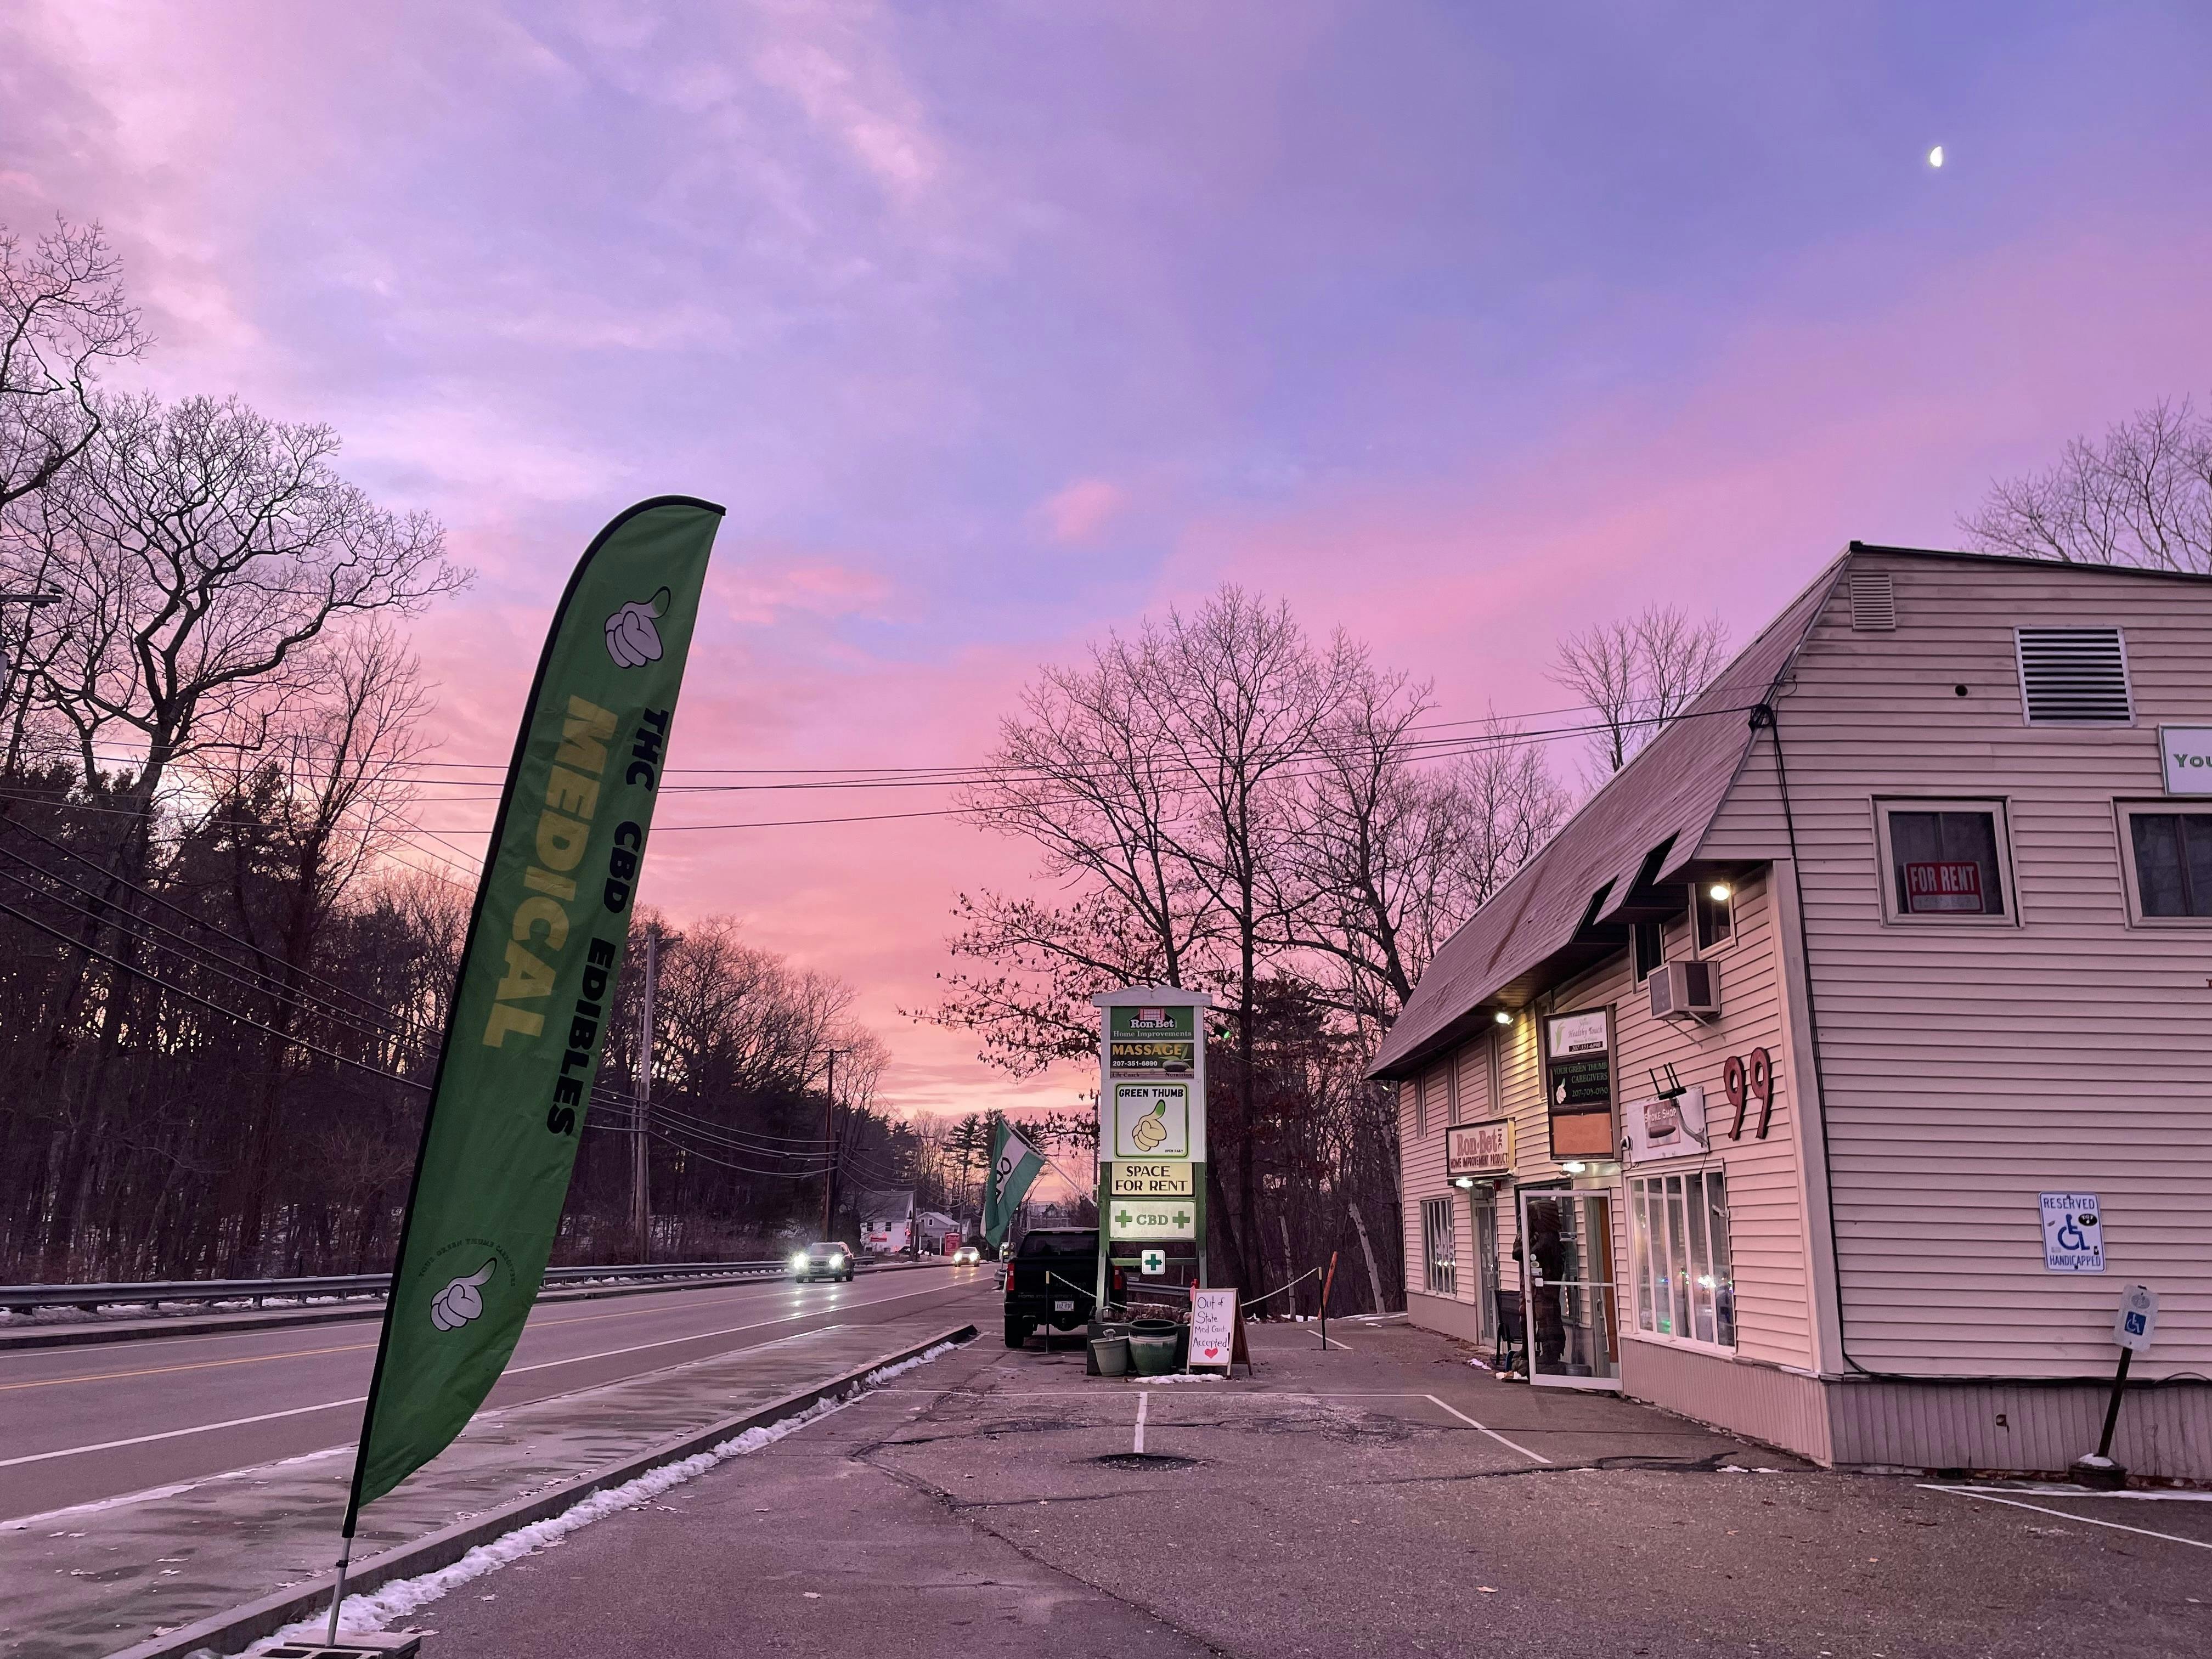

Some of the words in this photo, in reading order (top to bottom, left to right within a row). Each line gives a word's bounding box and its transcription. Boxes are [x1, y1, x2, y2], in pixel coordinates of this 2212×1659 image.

[626, 707, 670, 792] THC
[483, 695, 618, 1048] MEDICAL
[603, 821, 642, 914] CBD
[1910, 866, 1937, 892] FOR
[1940, 866, 1975, 891] RENT
[546, 936, 615, 1136] EDIBLES
[1112, 1045, 1182, 1056] MASSAGE
[1554, 1066, 1568, 1075] YOUR
[1569, 1064, 1586, 1073] GREEN
[1588, 1062, 1607, 1071] THUMB
[1572, 1072, 1608, 1084] CAREGIVERS
[1119, 1088, 1149, 1097] GREEN
[1152, 1088, 1183, 1097] THUMB
[1723, 1047, 1774, 1141] 99
[1662, 1108, 1677, 1119] SHOP
[1450, 1158, 1462, 1169] HOME
[1463, 1155, 1488, 1167] IMPROVEMENT
[1126, 1166, 1170, 1177] SPACE
[1115, 1180, 1143, 1191] FOR
[1149, 1180, 1188, 1191] RENT
[2044, 1198, 2095, 1209] RESERVED
[1136, 1215, 1168, 1225] CBD
[2050, 1255, 2101, 1266] HANDICAPPED
[1198, 1296, 1215, 1310] Out
[1218, 1297, 1224, 1307] of
[1196, 1311, 1218, 1324] State
[1195, 1325, 1209, 1334] Med
